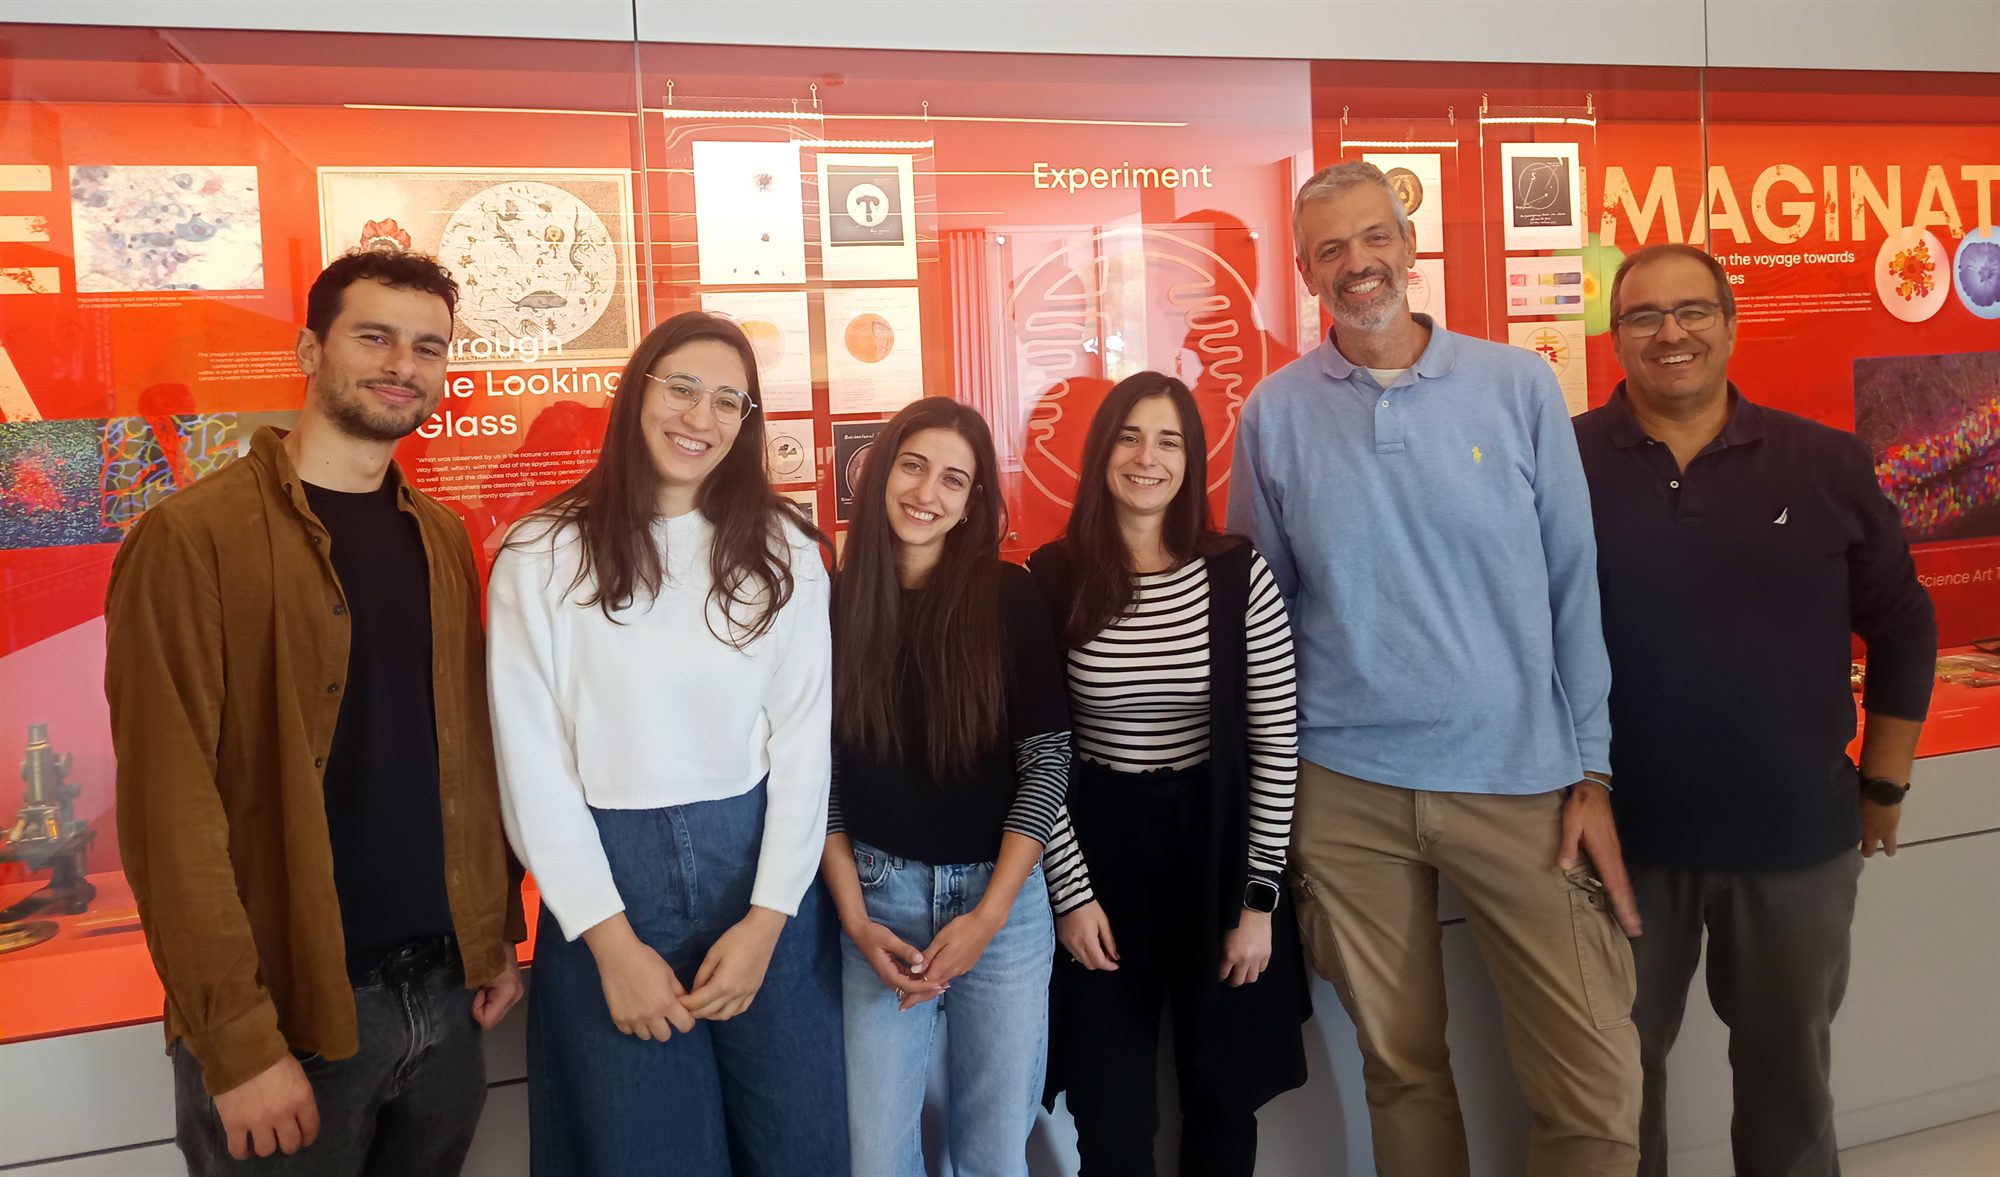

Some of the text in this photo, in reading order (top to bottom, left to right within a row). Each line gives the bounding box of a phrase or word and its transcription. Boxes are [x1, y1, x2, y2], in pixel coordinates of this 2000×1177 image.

[1033, 162, 1213, 194] Experiment
[1729, 253, 1751, 266] the
[1754, 254, 1801, 268] voyage
[1804, 251, 1855, 264] towards
[1726, 272, 1744, 284] ies
[447, 329, 563, 363] rough
[486, 367, 625, 398] Looking
[415, 411, 518, 439] Glass
[476, 473, 504, 481] disputes
[438, 484, 480, 493] philosophers
[493, 481, 526, 489] destroyed
[478, 492, 498, 500] wordy
[1917, 572, 1969, 588] Science
[1972, 568, 1993, 582] Art
